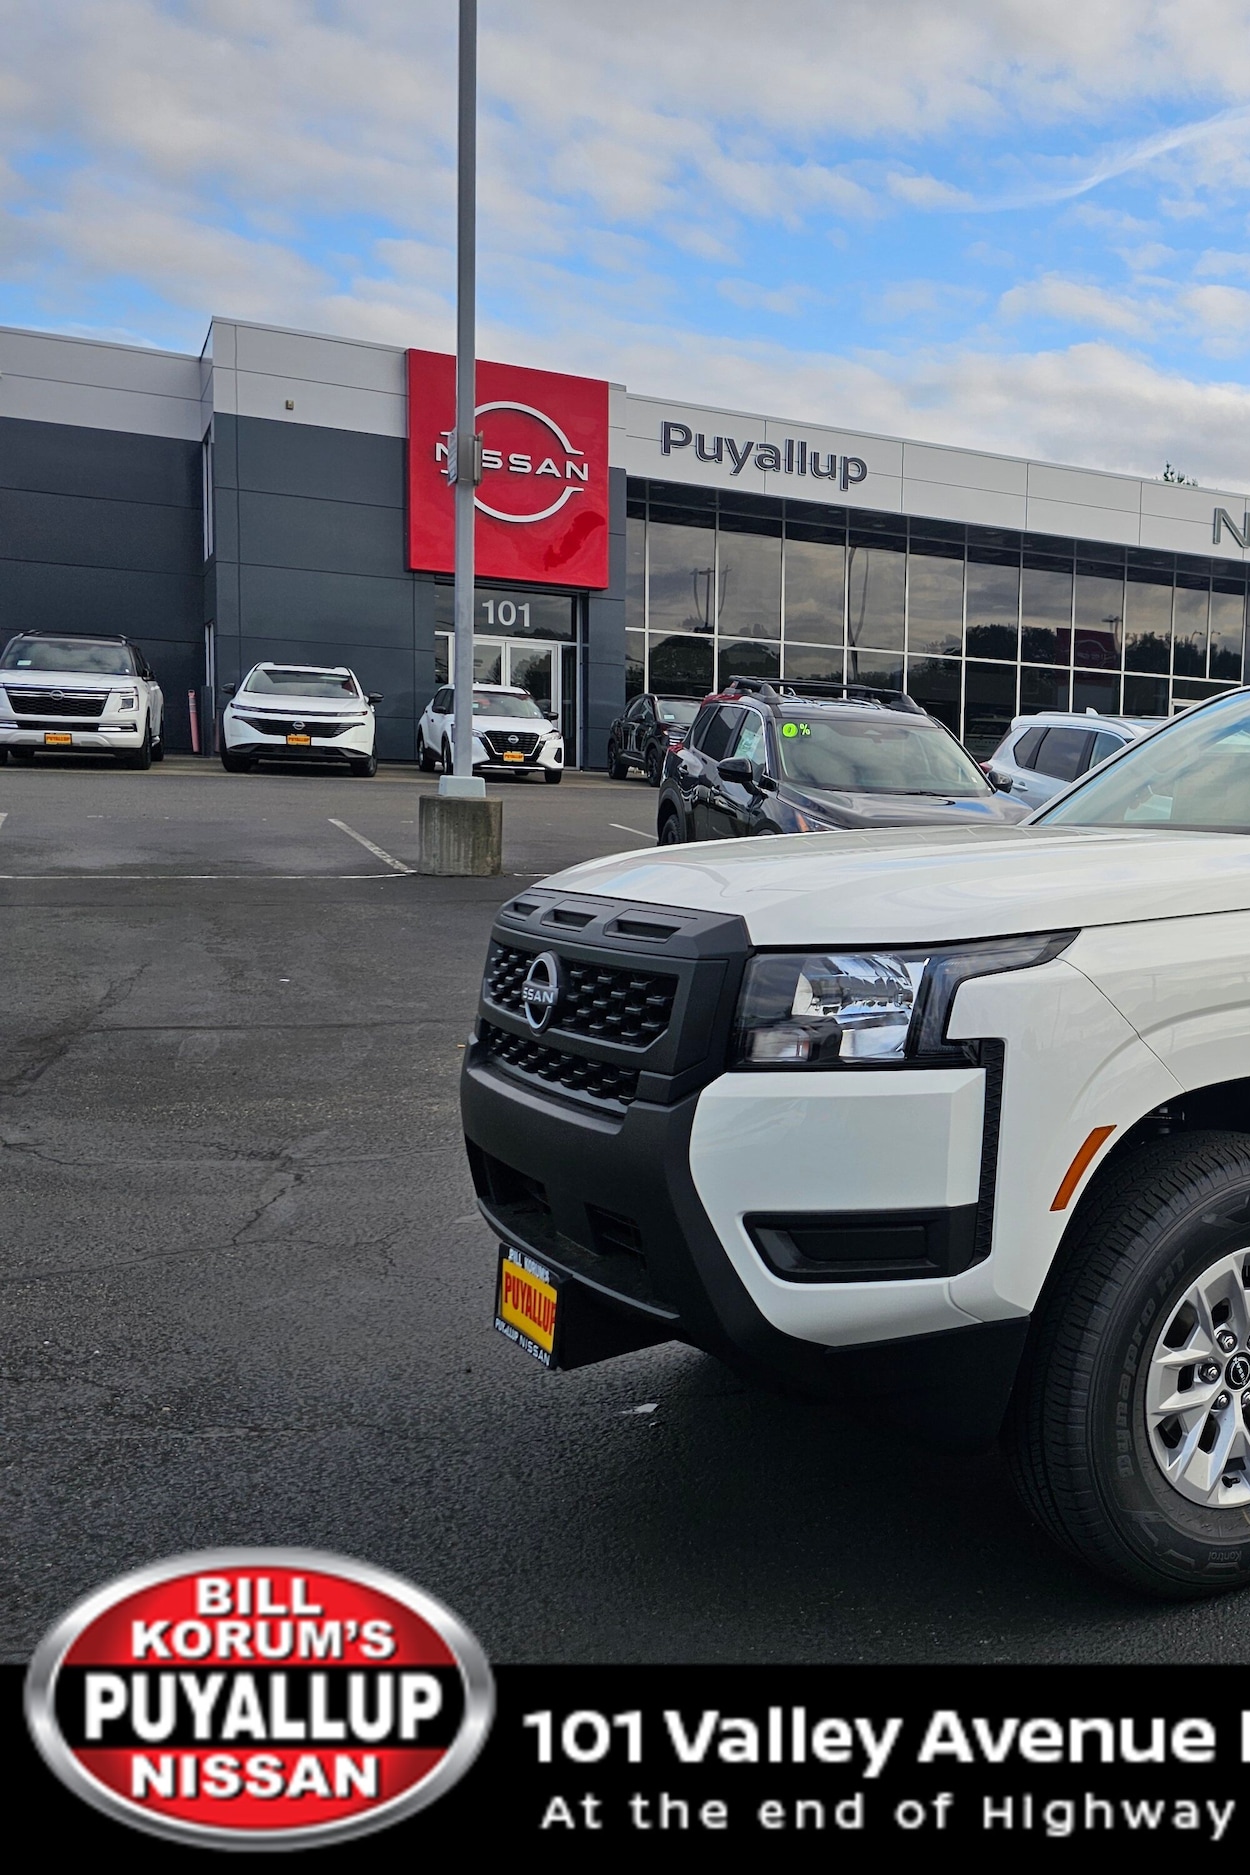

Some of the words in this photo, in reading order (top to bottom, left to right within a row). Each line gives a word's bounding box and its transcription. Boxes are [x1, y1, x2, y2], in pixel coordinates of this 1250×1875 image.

[435, 442, 589, 481] NSSAN
[660, 420, 868, 491] Puyallup
[482, 599, 530, 628] 101
[522, 986, 554, 1004] SSAN
[504, 1271, 557, 1336] PUYALLUP
[519, 1334, 551, 1367] NISSAN
